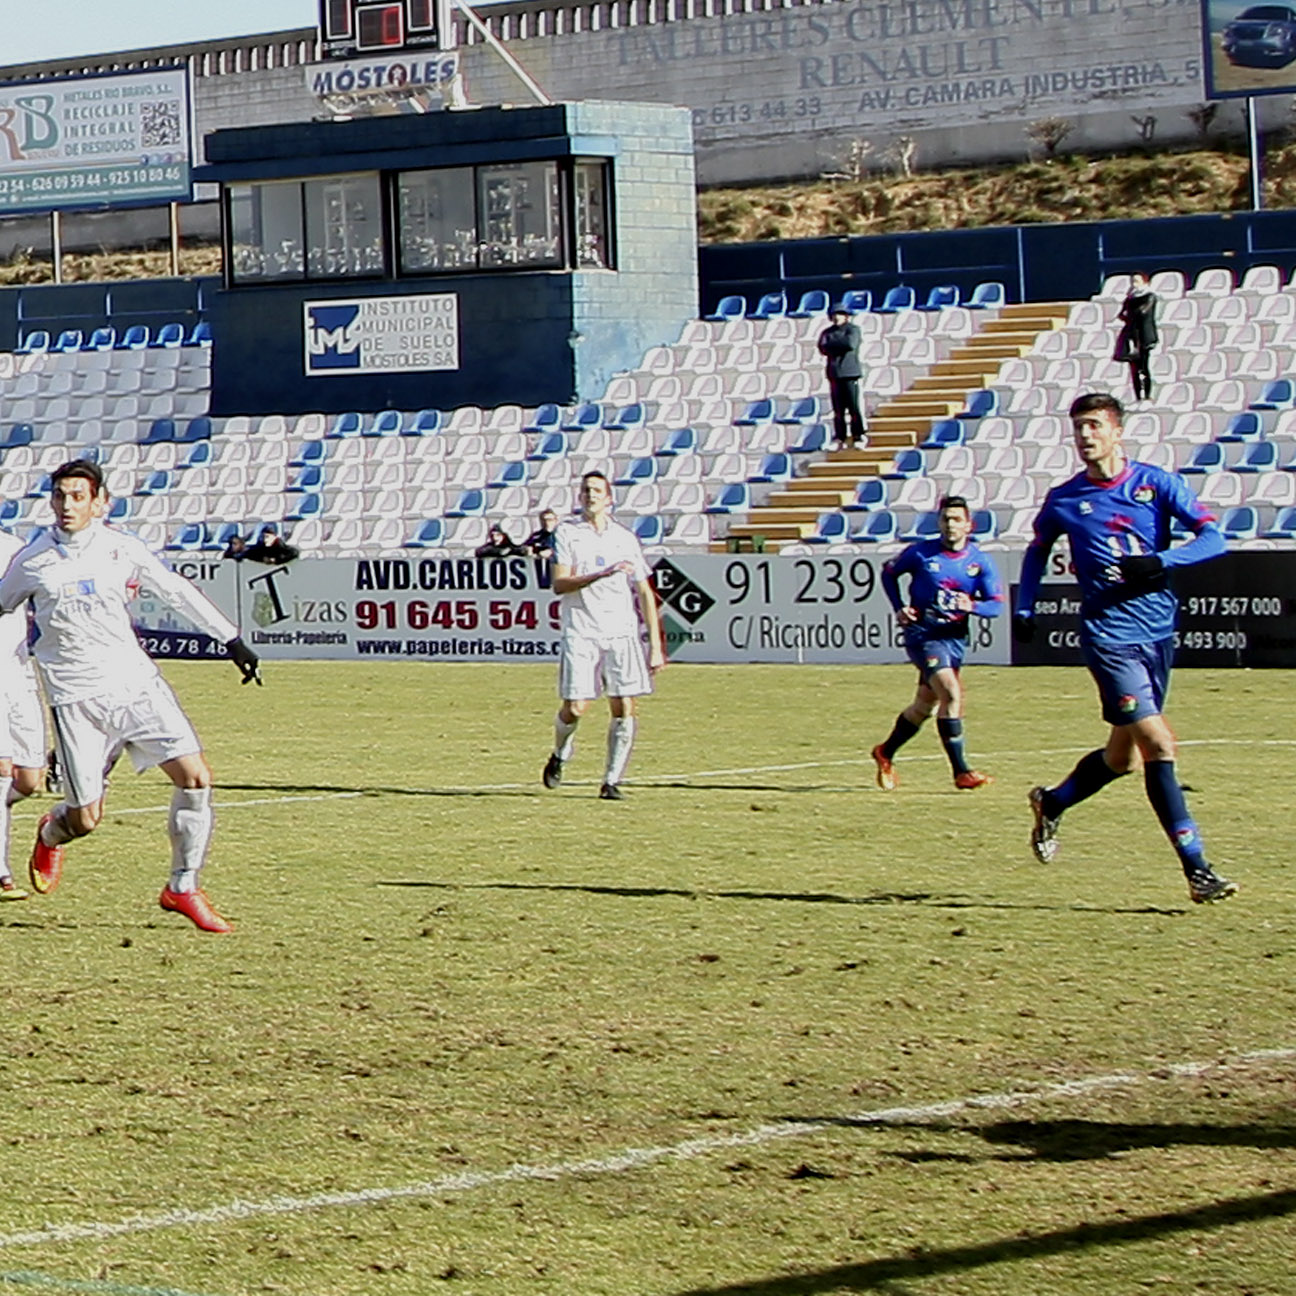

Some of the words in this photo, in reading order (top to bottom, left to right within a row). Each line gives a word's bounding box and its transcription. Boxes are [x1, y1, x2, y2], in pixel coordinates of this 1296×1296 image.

[618, 14, 830, 65] TALLERES
[799, 36, 1009, 89] RENAULT
[794, 97, 821, 116] 33
[906, 76, 1014, 106] CAMARA
[64, 103, 135, 120] RECICLAJE
[64, 122, 135, 139] INTEGRAL
[64, 143, 79, 156] DE
[81, 139, 136, 155] RESIDUOS
[361, 298, 454, 315] INSTITUTO
[361, 316, 454, 333] MUNICIPAL
[362, 336, 384, 352] DE
[400, 334, 455, 351] SUELO
[656, 568, 674, 590] E
[725, 560, 771, 605] 91
[794, 559, 875, 604] 239
[248, 565, 348, 624] Tizas
[680, 591, 702, 613] G
[355, 600, 397, 629] 91
[407, 600, 478, 629] 645
[489, 600, 538, 629] 54
[1220, 597, 1249, 615] 567
[1251, 597, 1281, 615] 000
[729, 615, 754, 650] C/
[760, 614, 846, 649] Ricardo
[852, 614, 880, 649] de
[1183, 631, 1213, 649] 493
[1217, 631, 1247, 649] 900
[176, 638, 199, 654] 78
